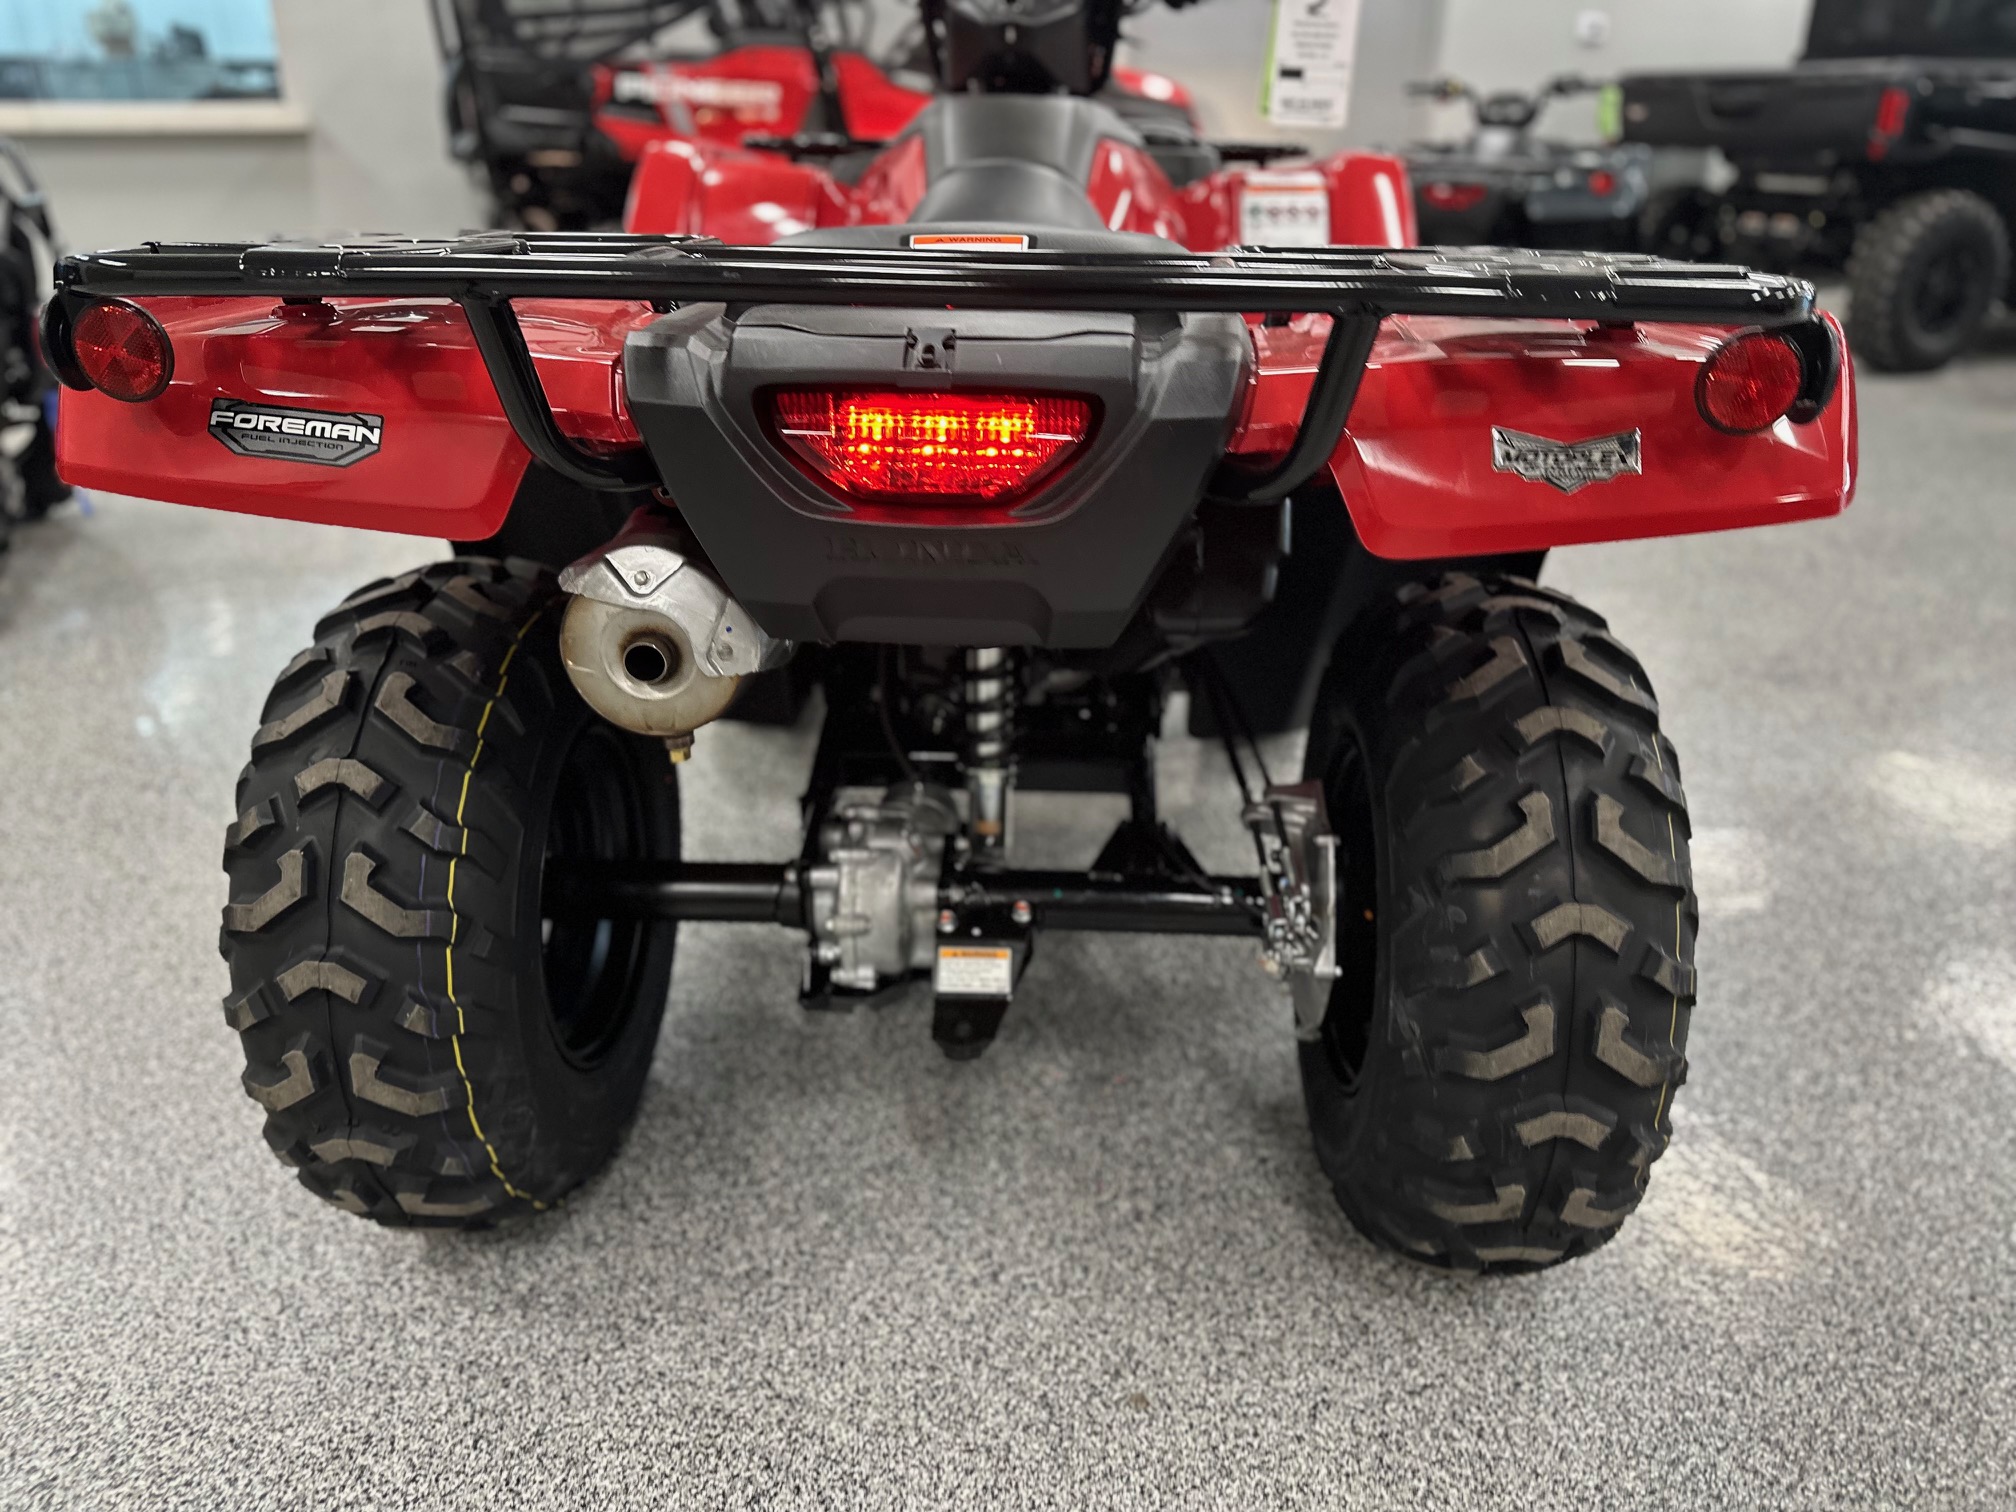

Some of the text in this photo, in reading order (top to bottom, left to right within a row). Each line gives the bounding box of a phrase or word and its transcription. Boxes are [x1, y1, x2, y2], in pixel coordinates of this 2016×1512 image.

[948, 236, 1002, 244] WARNING
[210, 411, 381, 444] FOREMAN
[241, 433, 344, 451] FUEL INJECTION
[825, 537, 1039, 566] HONDA
